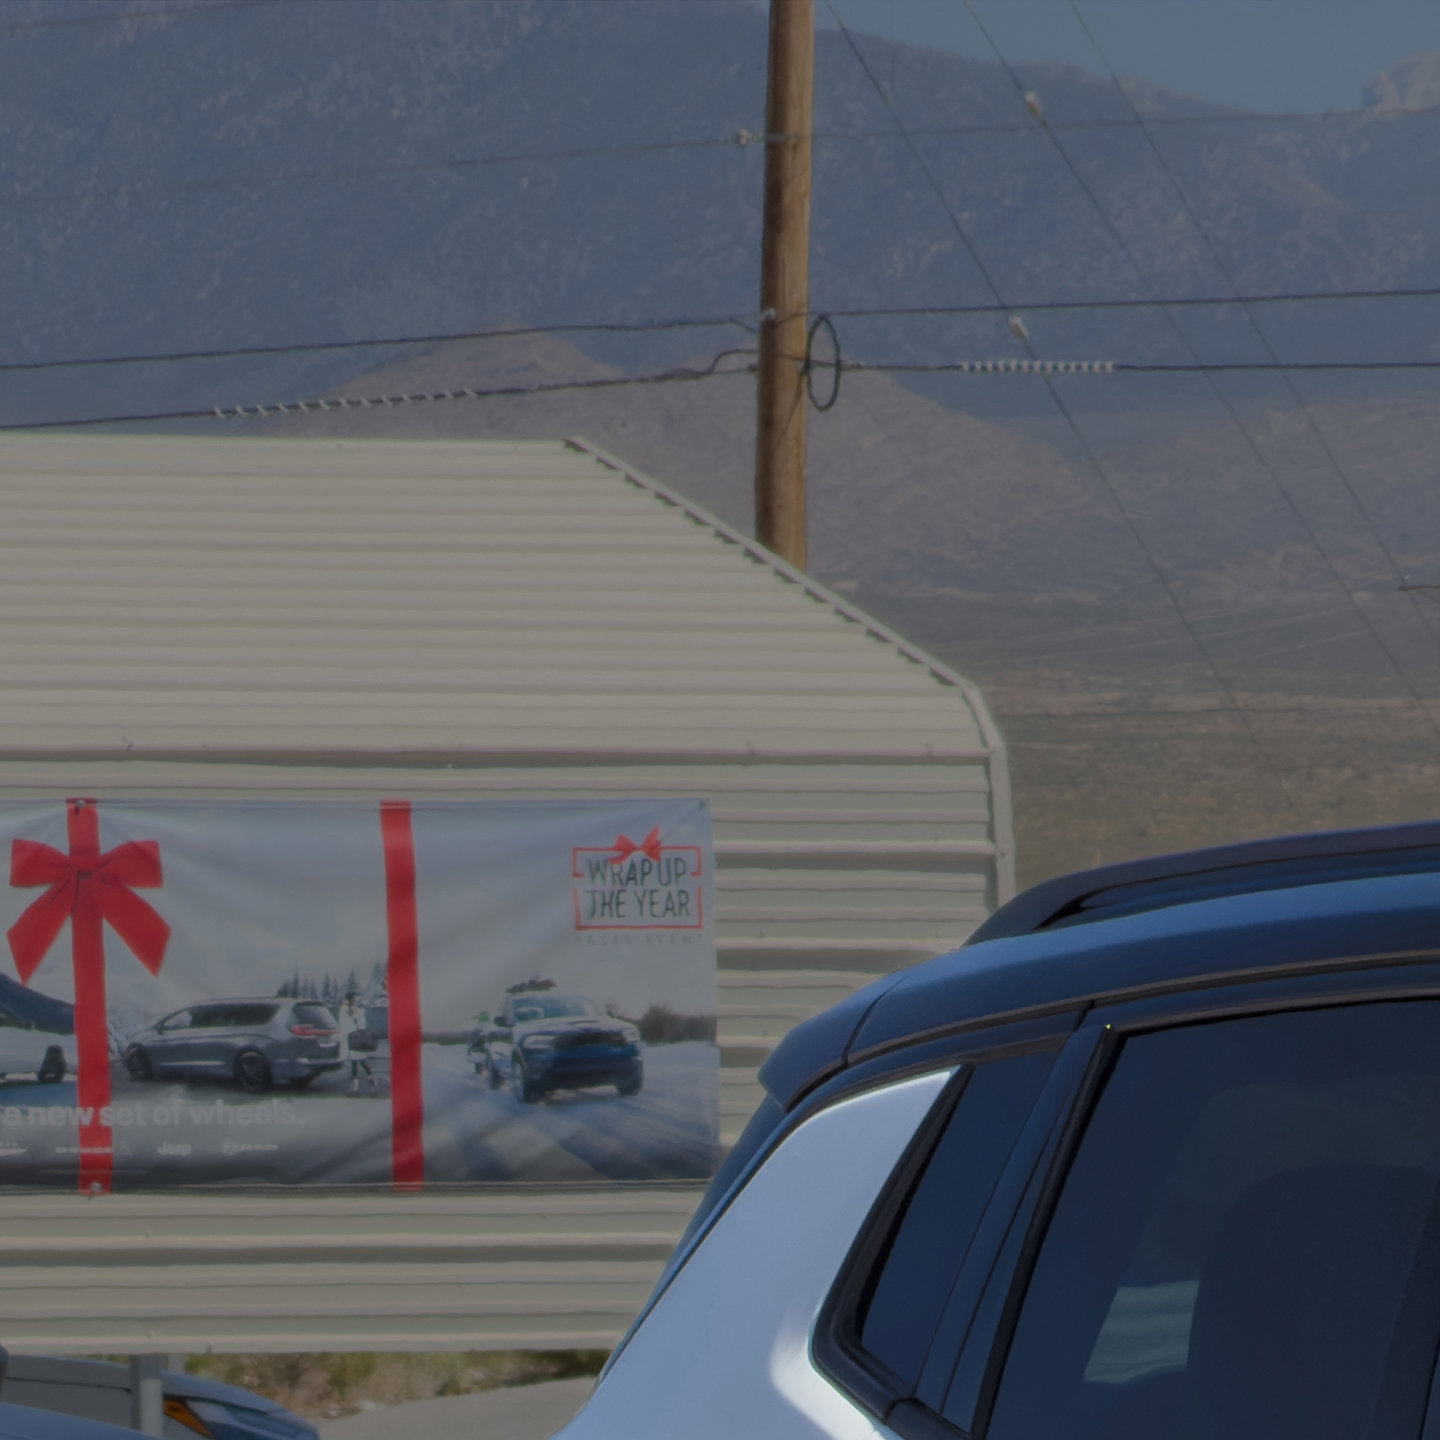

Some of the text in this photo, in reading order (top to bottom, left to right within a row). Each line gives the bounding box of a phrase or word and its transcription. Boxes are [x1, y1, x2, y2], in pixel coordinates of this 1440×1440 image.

[587, 857, 687, 887] WRAP UP
[585, 888, 691, 919] THE YEAR
[3, 1107, 21, 1127] a
[27, 1107, 95, 1128] new
[99, 1106, 147, 1127] set
[152, 1102, 181, 1127] of
